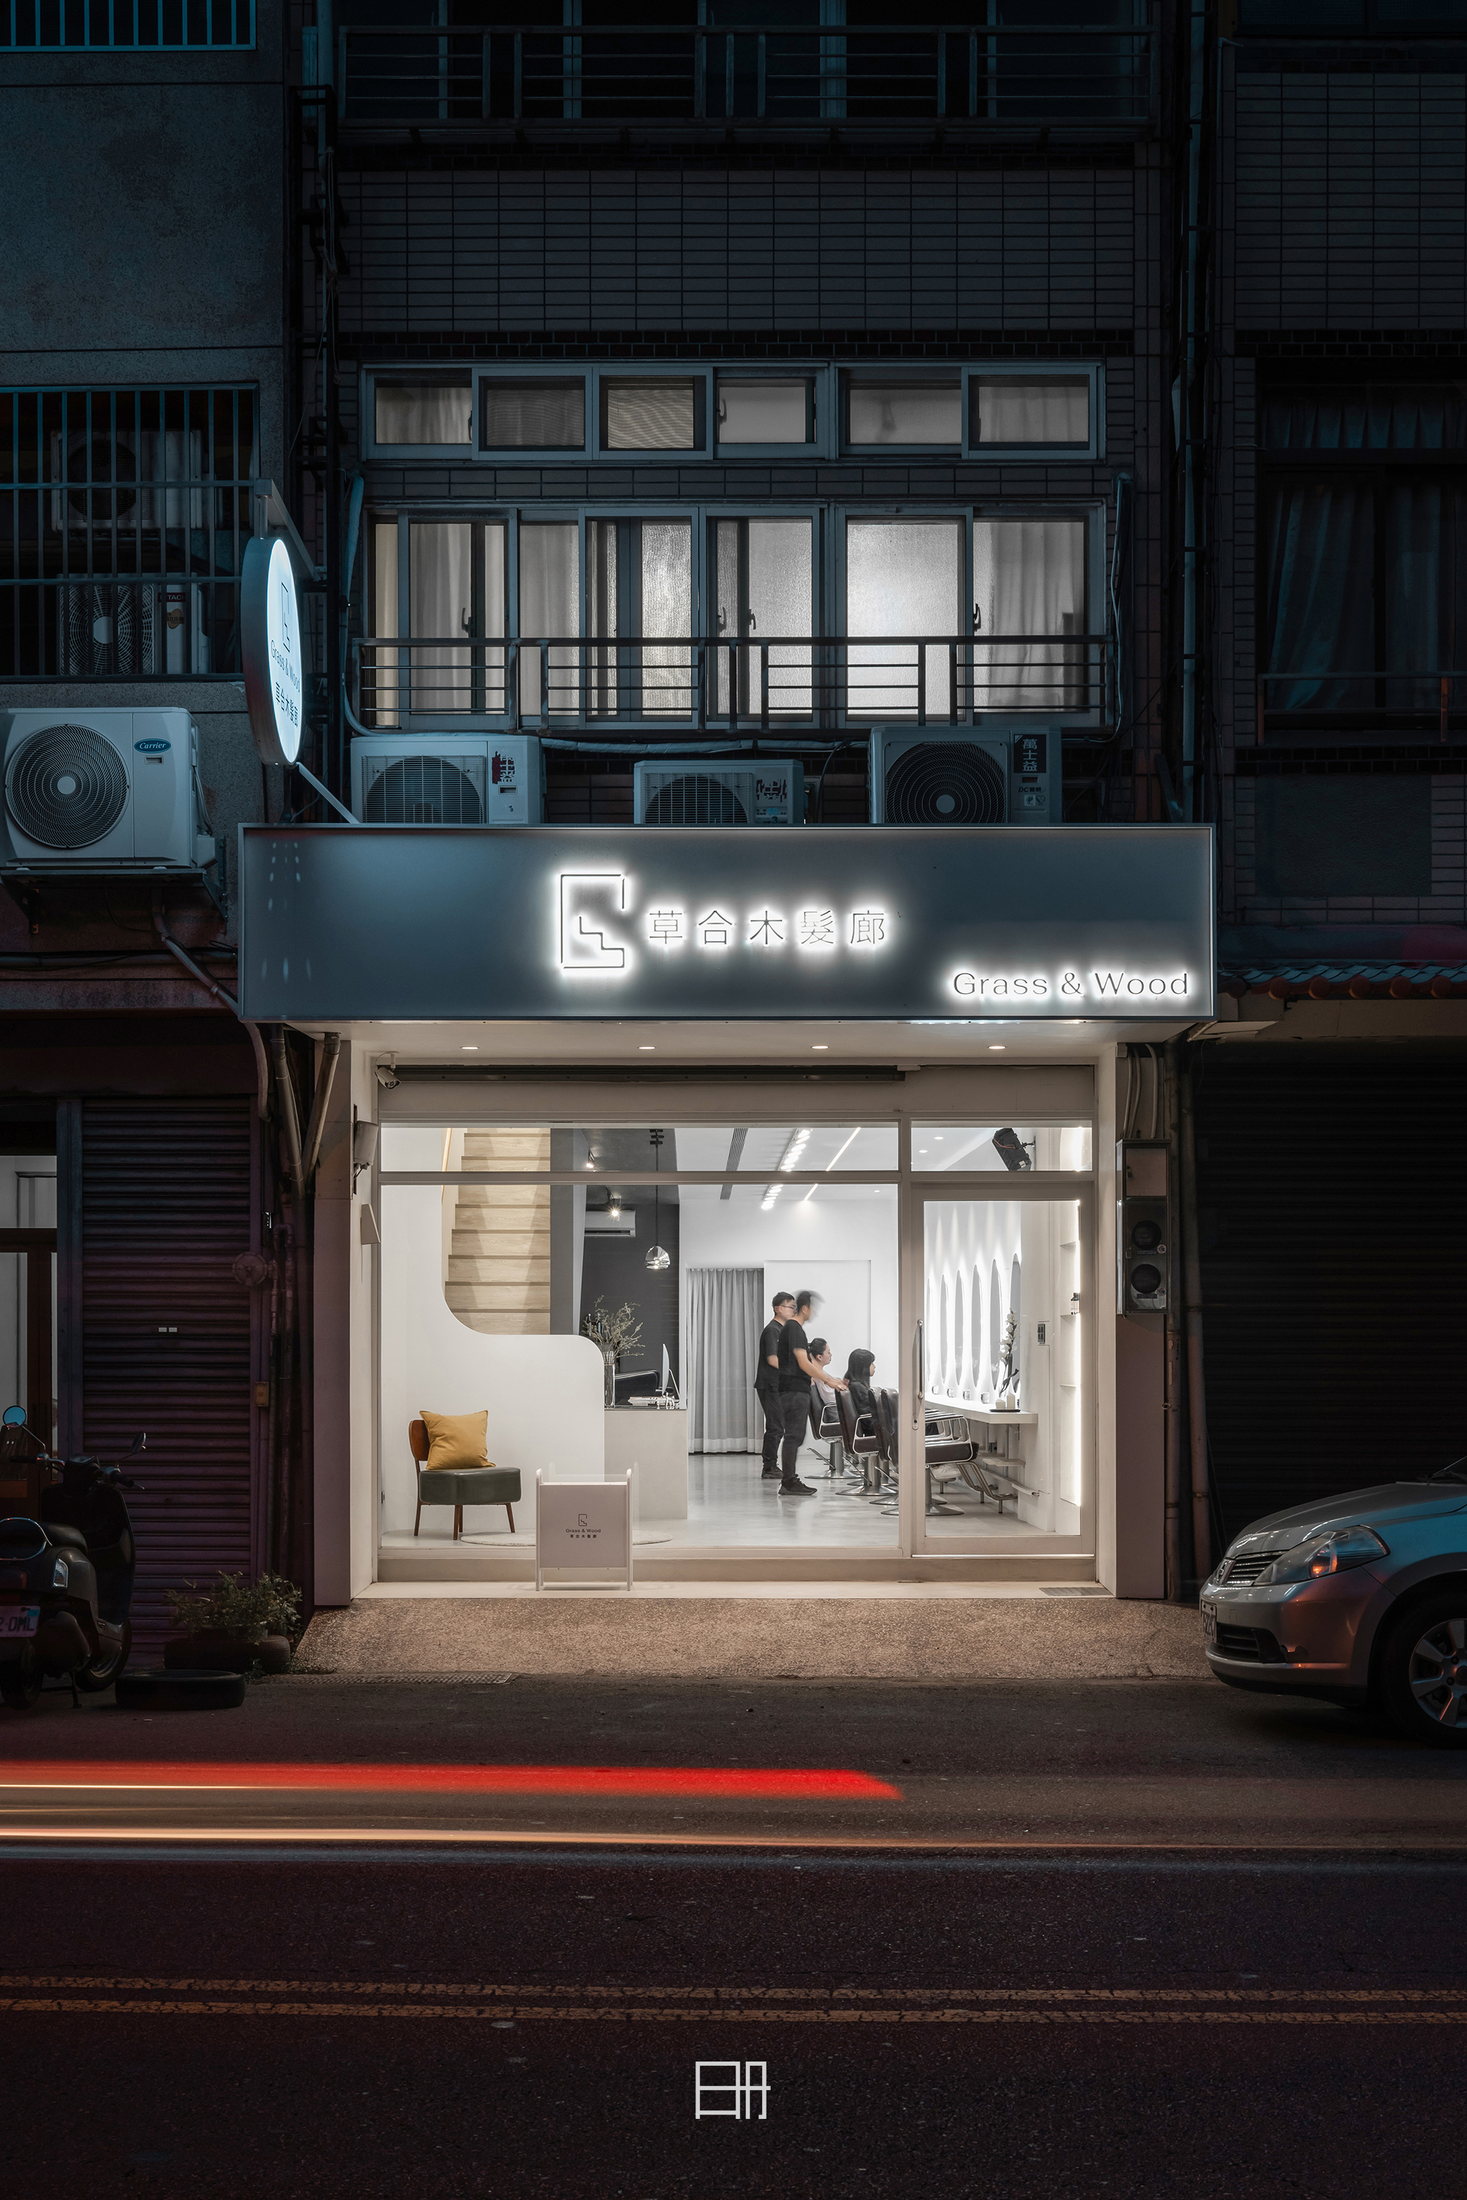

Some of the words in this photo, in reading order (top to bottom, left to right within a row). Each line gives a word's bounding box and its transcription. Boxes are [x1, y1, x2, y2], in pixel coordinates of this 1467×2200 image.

[139, 741, 167, 750] Carrier
[1022, 737, 1038, 772] 萬士益
[649, 909, 886, 946] 草合木髮廊
[953, 971, 1048, 996] Grass
[1060, 971, 1083, 996] &
[1094, 971, 1189, 996] Wood
